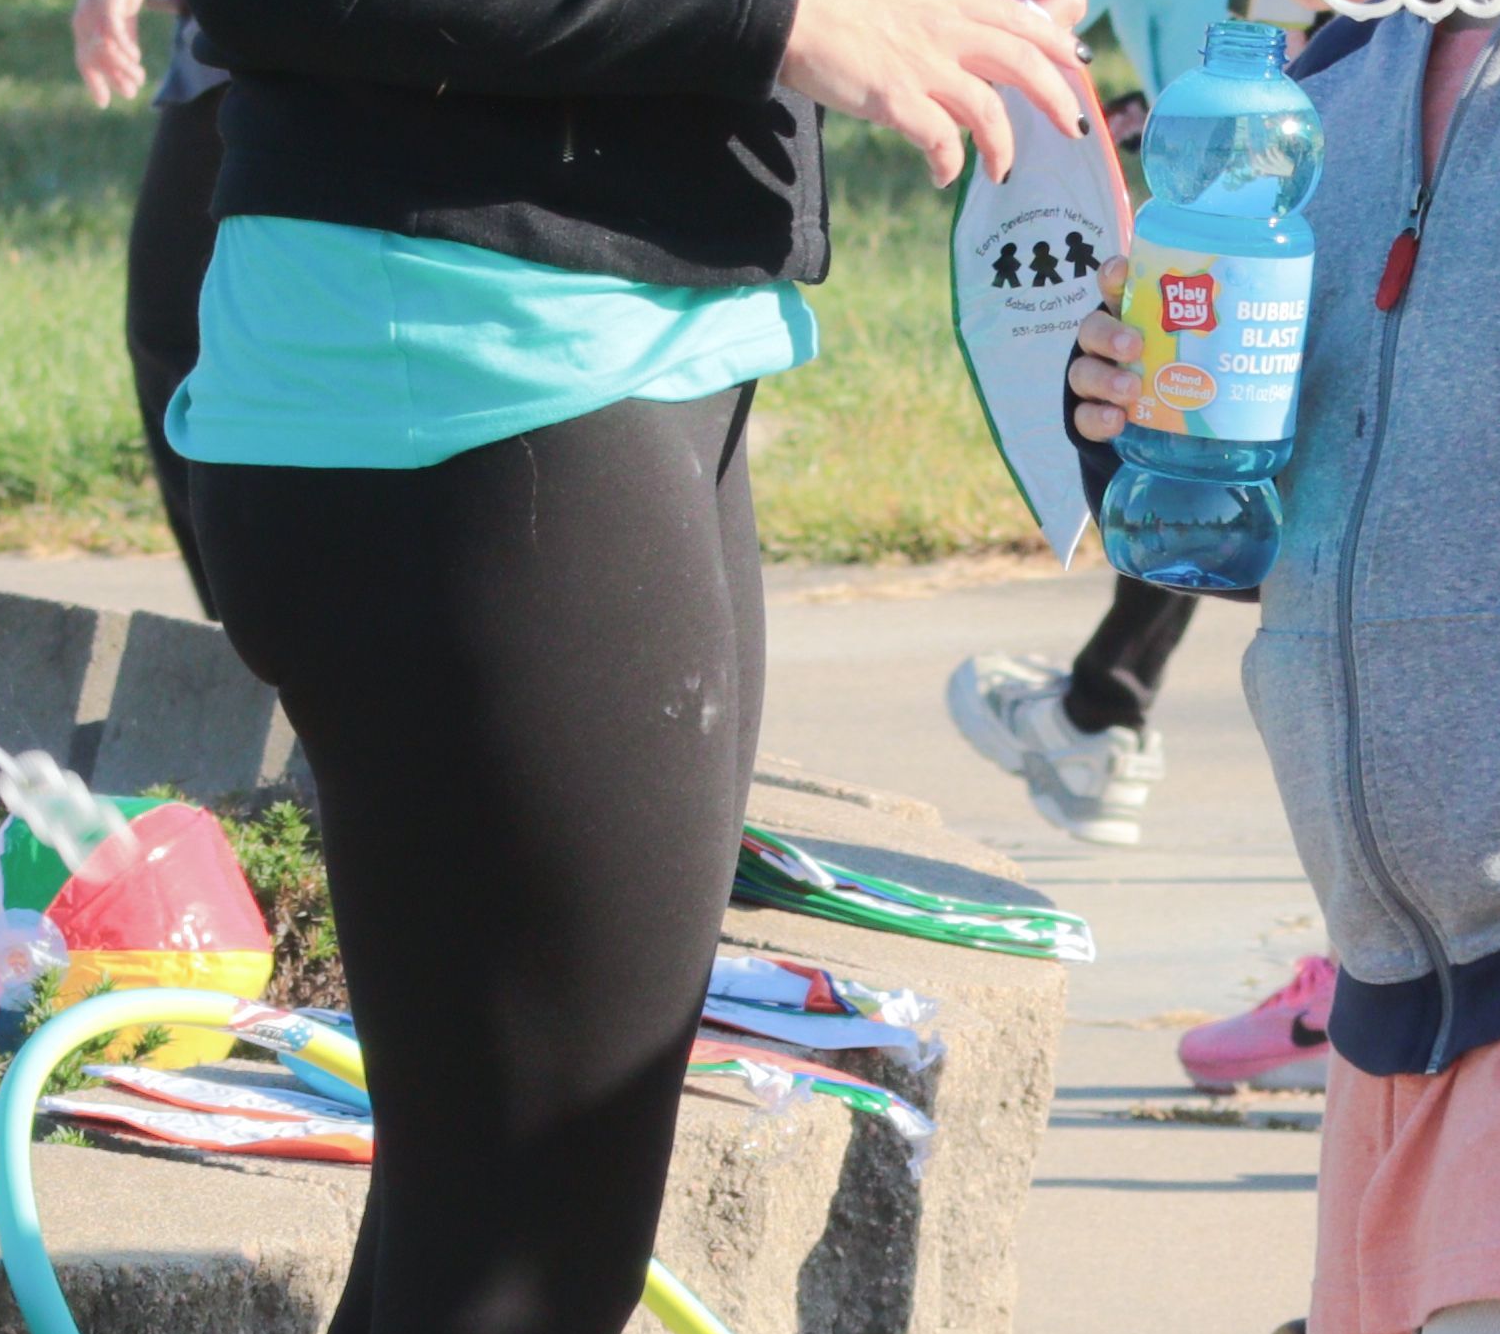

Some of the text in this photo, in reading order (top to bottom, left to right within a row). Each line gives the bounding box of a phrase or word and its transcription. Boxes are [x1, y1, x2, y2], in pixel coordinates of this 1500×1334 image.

[975, 207, 1105, 257] Early Development Network
[1005, 287, 1088, 312] Babies Can't Wait
[1166, 281, 1206, 301] Play
[1169, 301, 1208, 324] Day
[1237, 299, 1305, 321] BUBBLE
[1011, 319, 1079, 337] 531-299-024
[1242, 327, 1298, 348] BLAST
[1218, 352, 1302, 375] SOLUTIO
